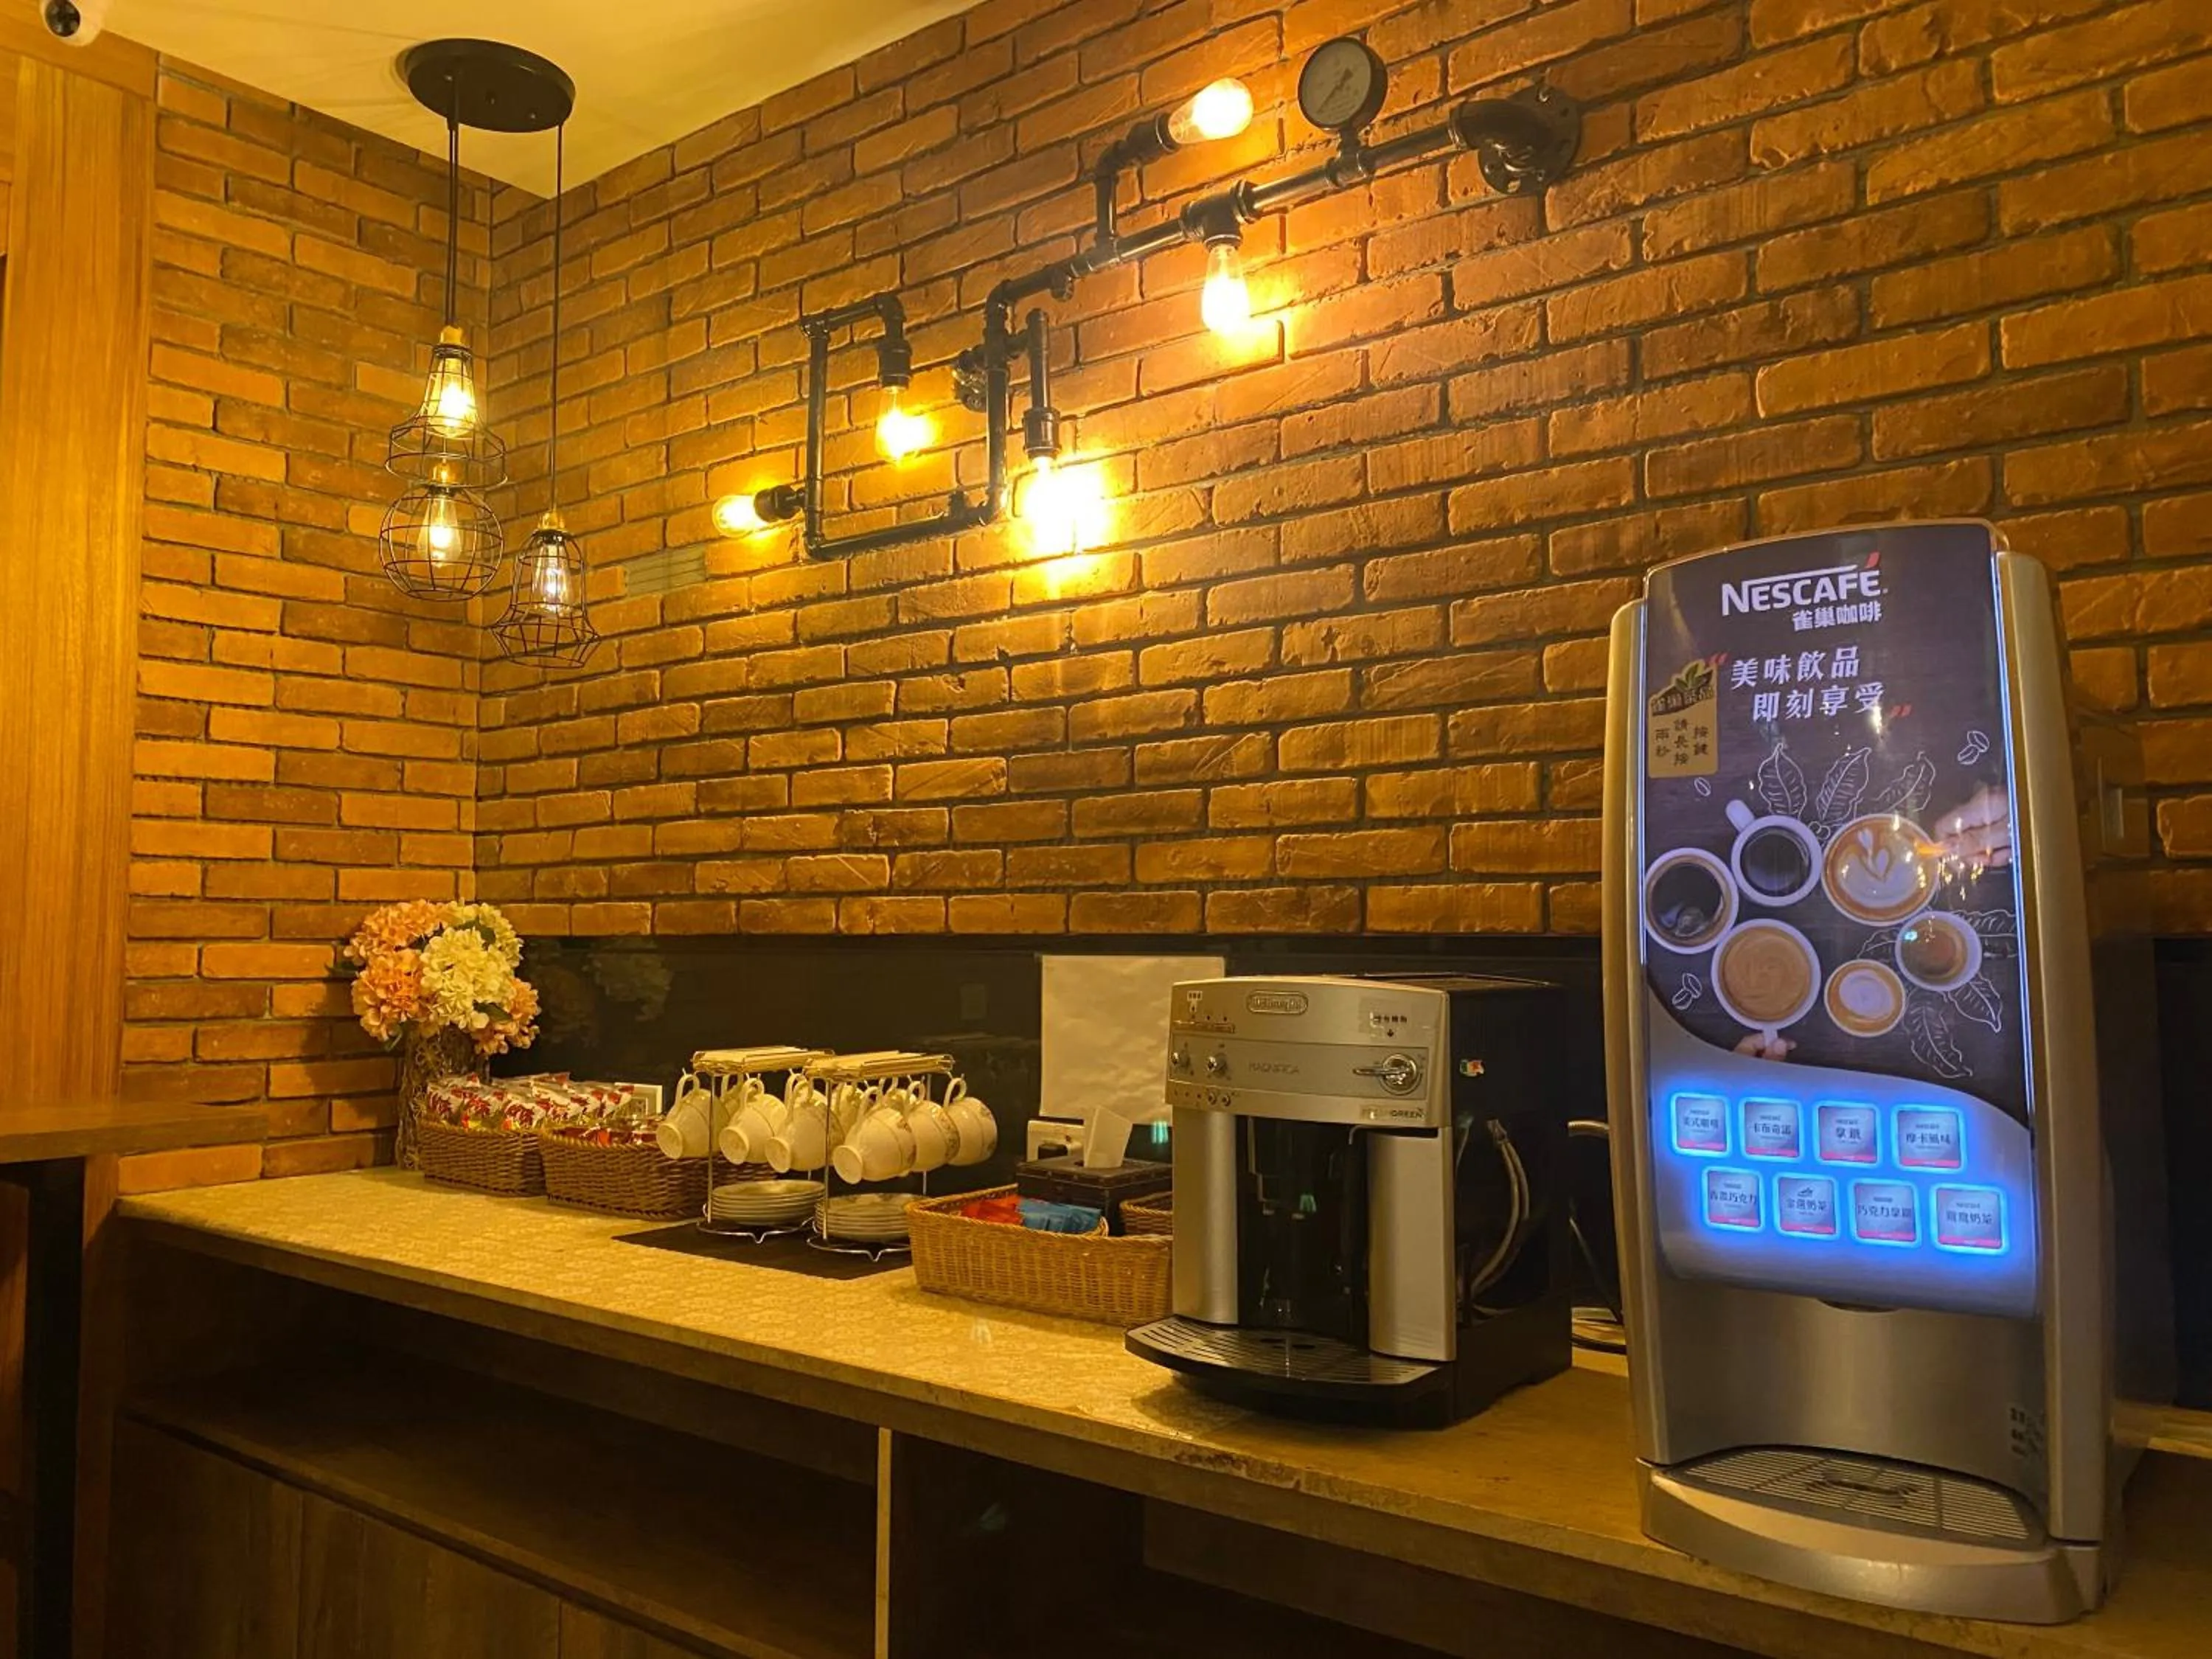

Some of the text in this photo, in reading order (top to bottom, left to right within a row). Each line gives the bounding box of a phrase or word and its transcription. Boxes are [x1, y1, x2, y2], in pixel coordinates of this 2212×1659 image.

[1722, 552, 1882, 616] NESCAFÉ
[1792, 602, 1882, 631] 雀巢咖啡
[1731, 646, 1860, 689] 美味飲品
[1753, 682, 1885, 723] 即刻享受
